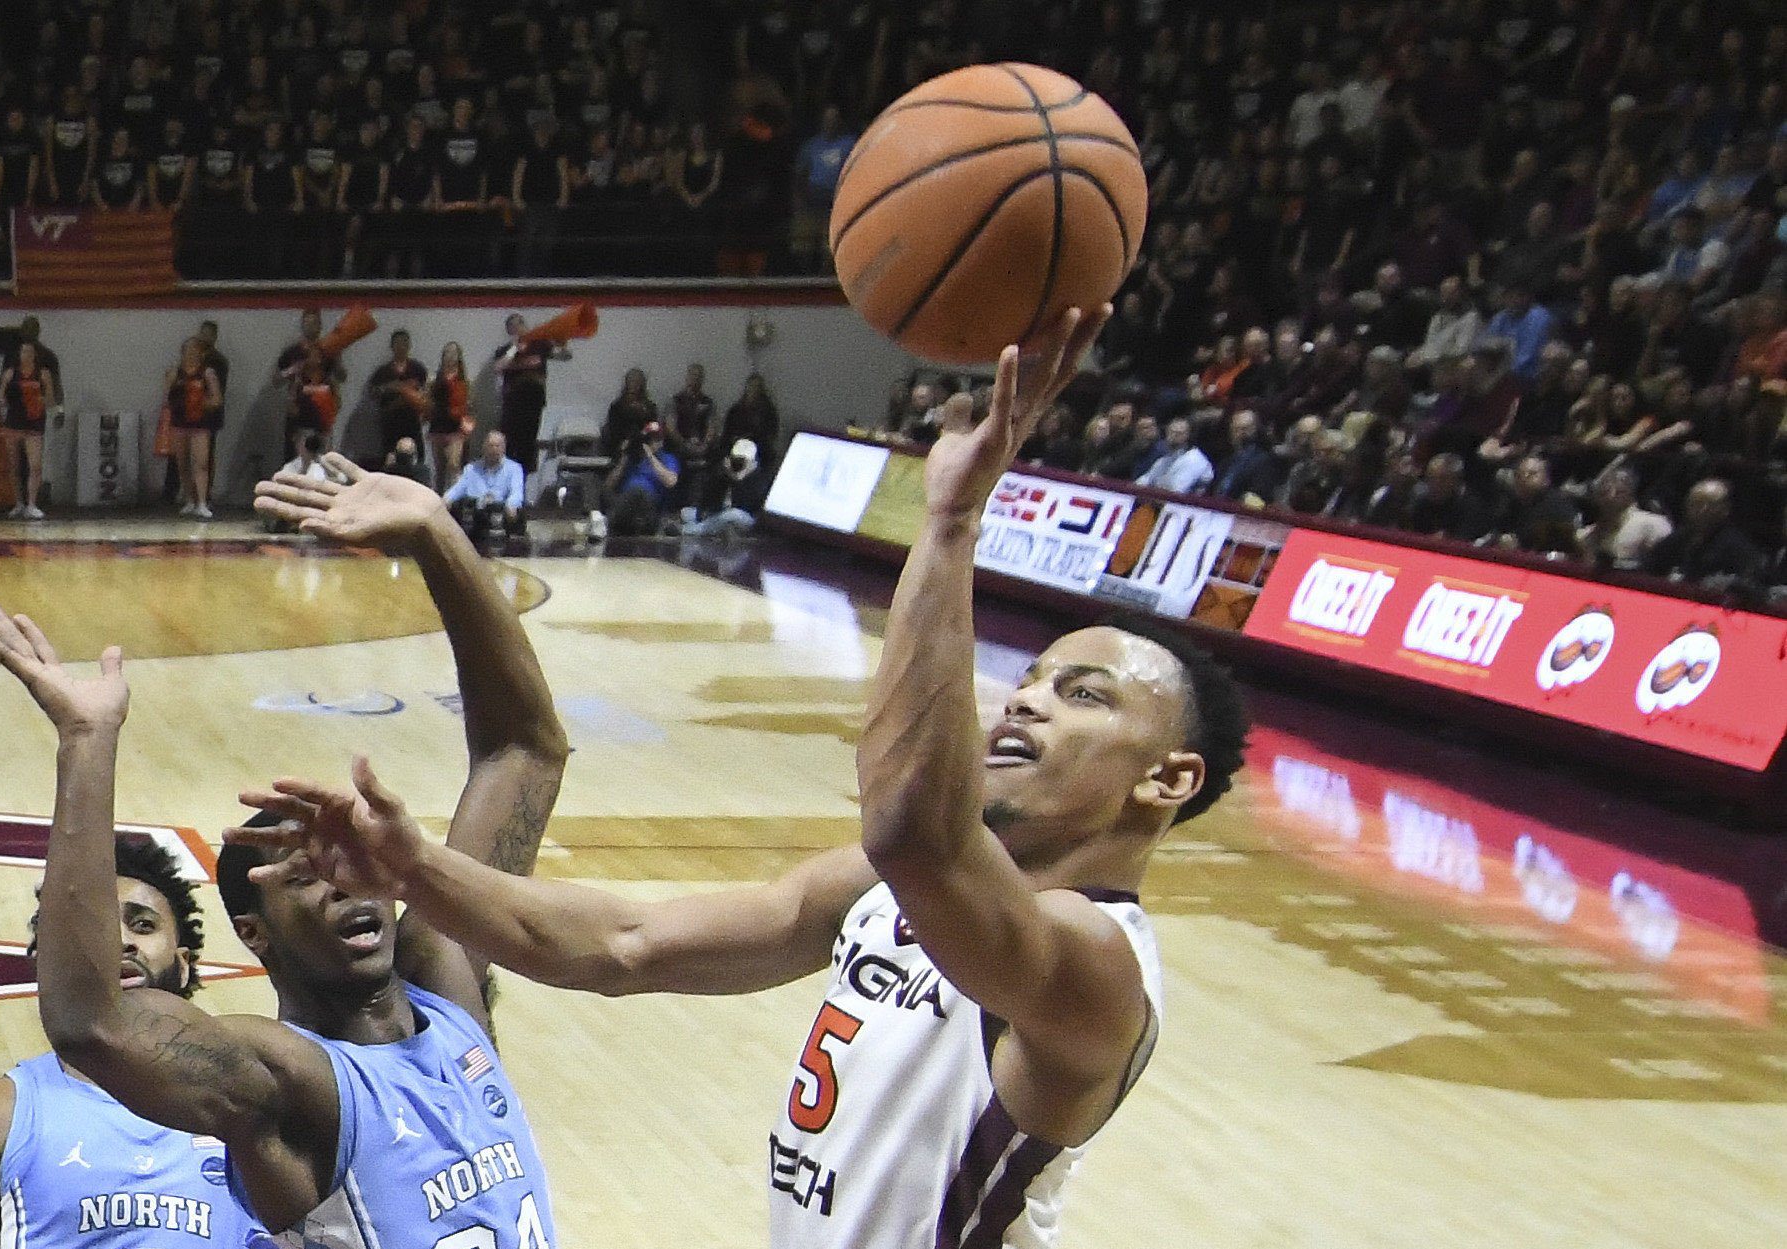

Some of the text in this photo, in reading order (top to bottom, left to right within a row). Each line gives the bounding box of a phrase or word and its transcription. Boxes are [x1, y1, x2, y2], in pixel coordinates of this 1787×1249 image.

[29, 214, 78, 241] VT
[788, 1000, 864, 1134] 5
[78, 1193, 212, 1239] NORTH
